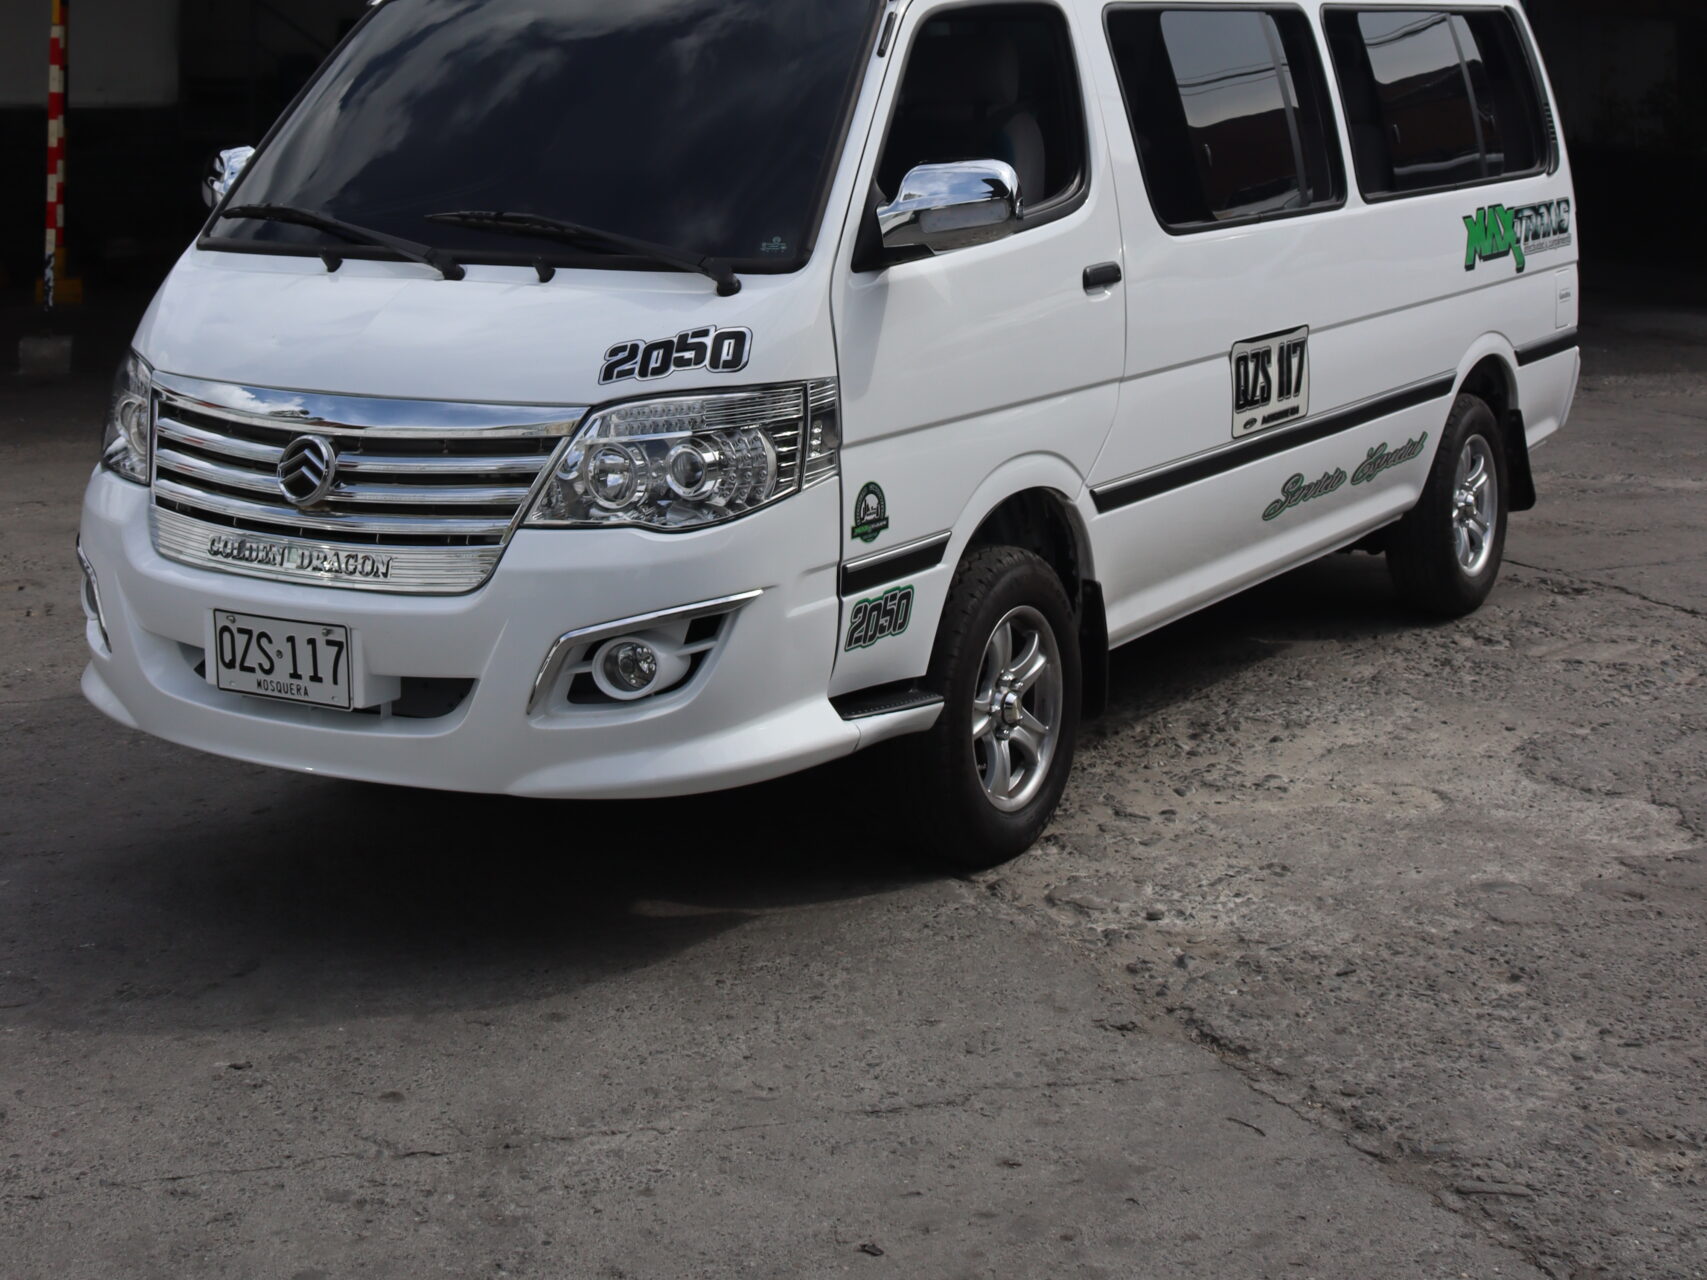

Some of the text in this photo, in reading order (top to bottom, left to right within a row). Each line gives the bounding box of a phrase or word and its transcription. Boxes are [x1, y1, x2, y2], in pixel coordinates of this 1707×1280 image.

[1462, 203, 1525, 273] MAX
[599, 325, 752, 384] 2050
[1277, 337, 1306, 402] 117
[207, 535, 394, 578] GOLDEN DRAGON
[845, 585, 914, 651] 2050
[256, 678, 309, 697] MOSQUERA
